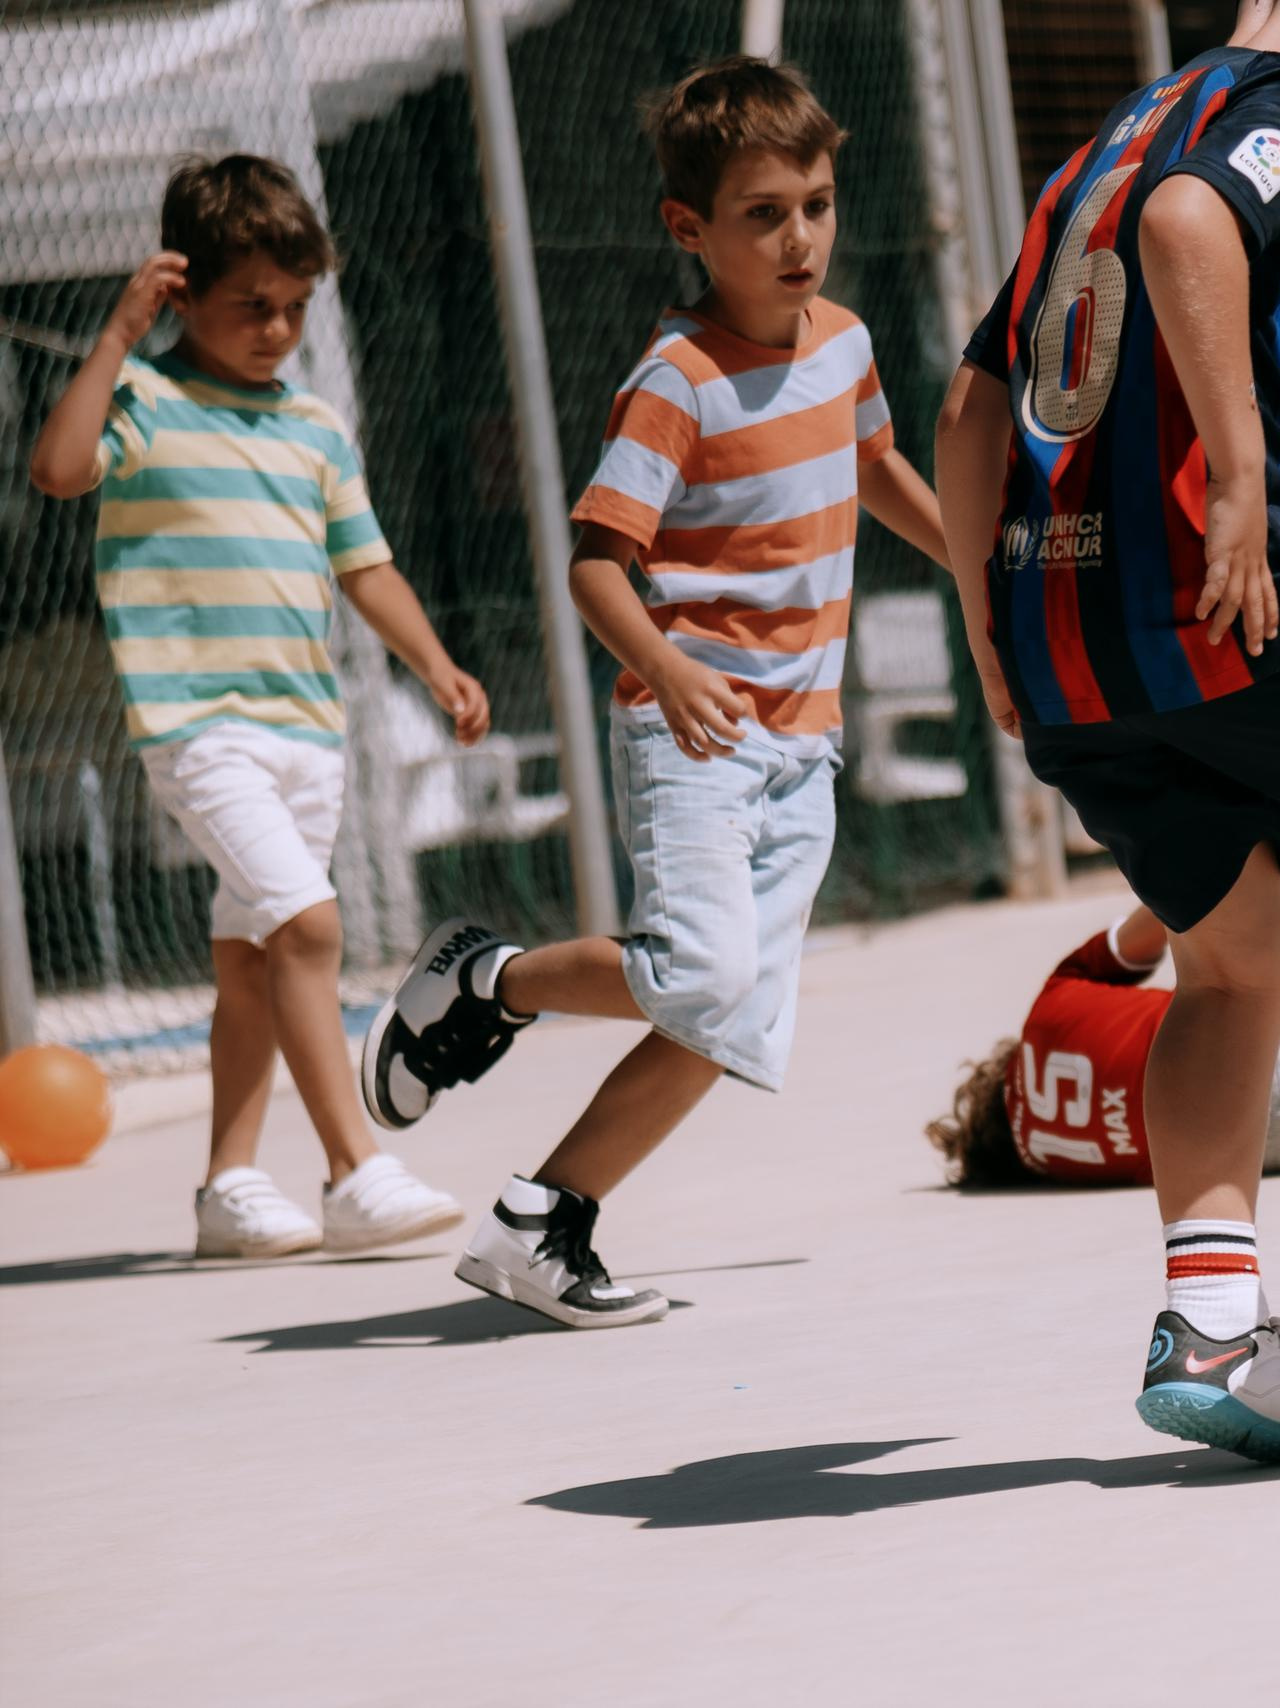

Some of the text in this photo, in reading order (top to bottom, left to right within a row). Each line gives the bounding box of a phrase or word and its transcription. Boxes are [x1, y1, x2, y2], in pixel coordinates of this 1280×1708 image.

[1239, 153, 1273, 193] LaLiga
[1022, 162, 1143, 443] 6
[1037, 535, 1102, 560] ACNUR
[1043, 511, 1102, 537] UNHCR
[1023, 1042, 1105, 1164] 15
[1102, 1087, 1138, 1155] MAX
